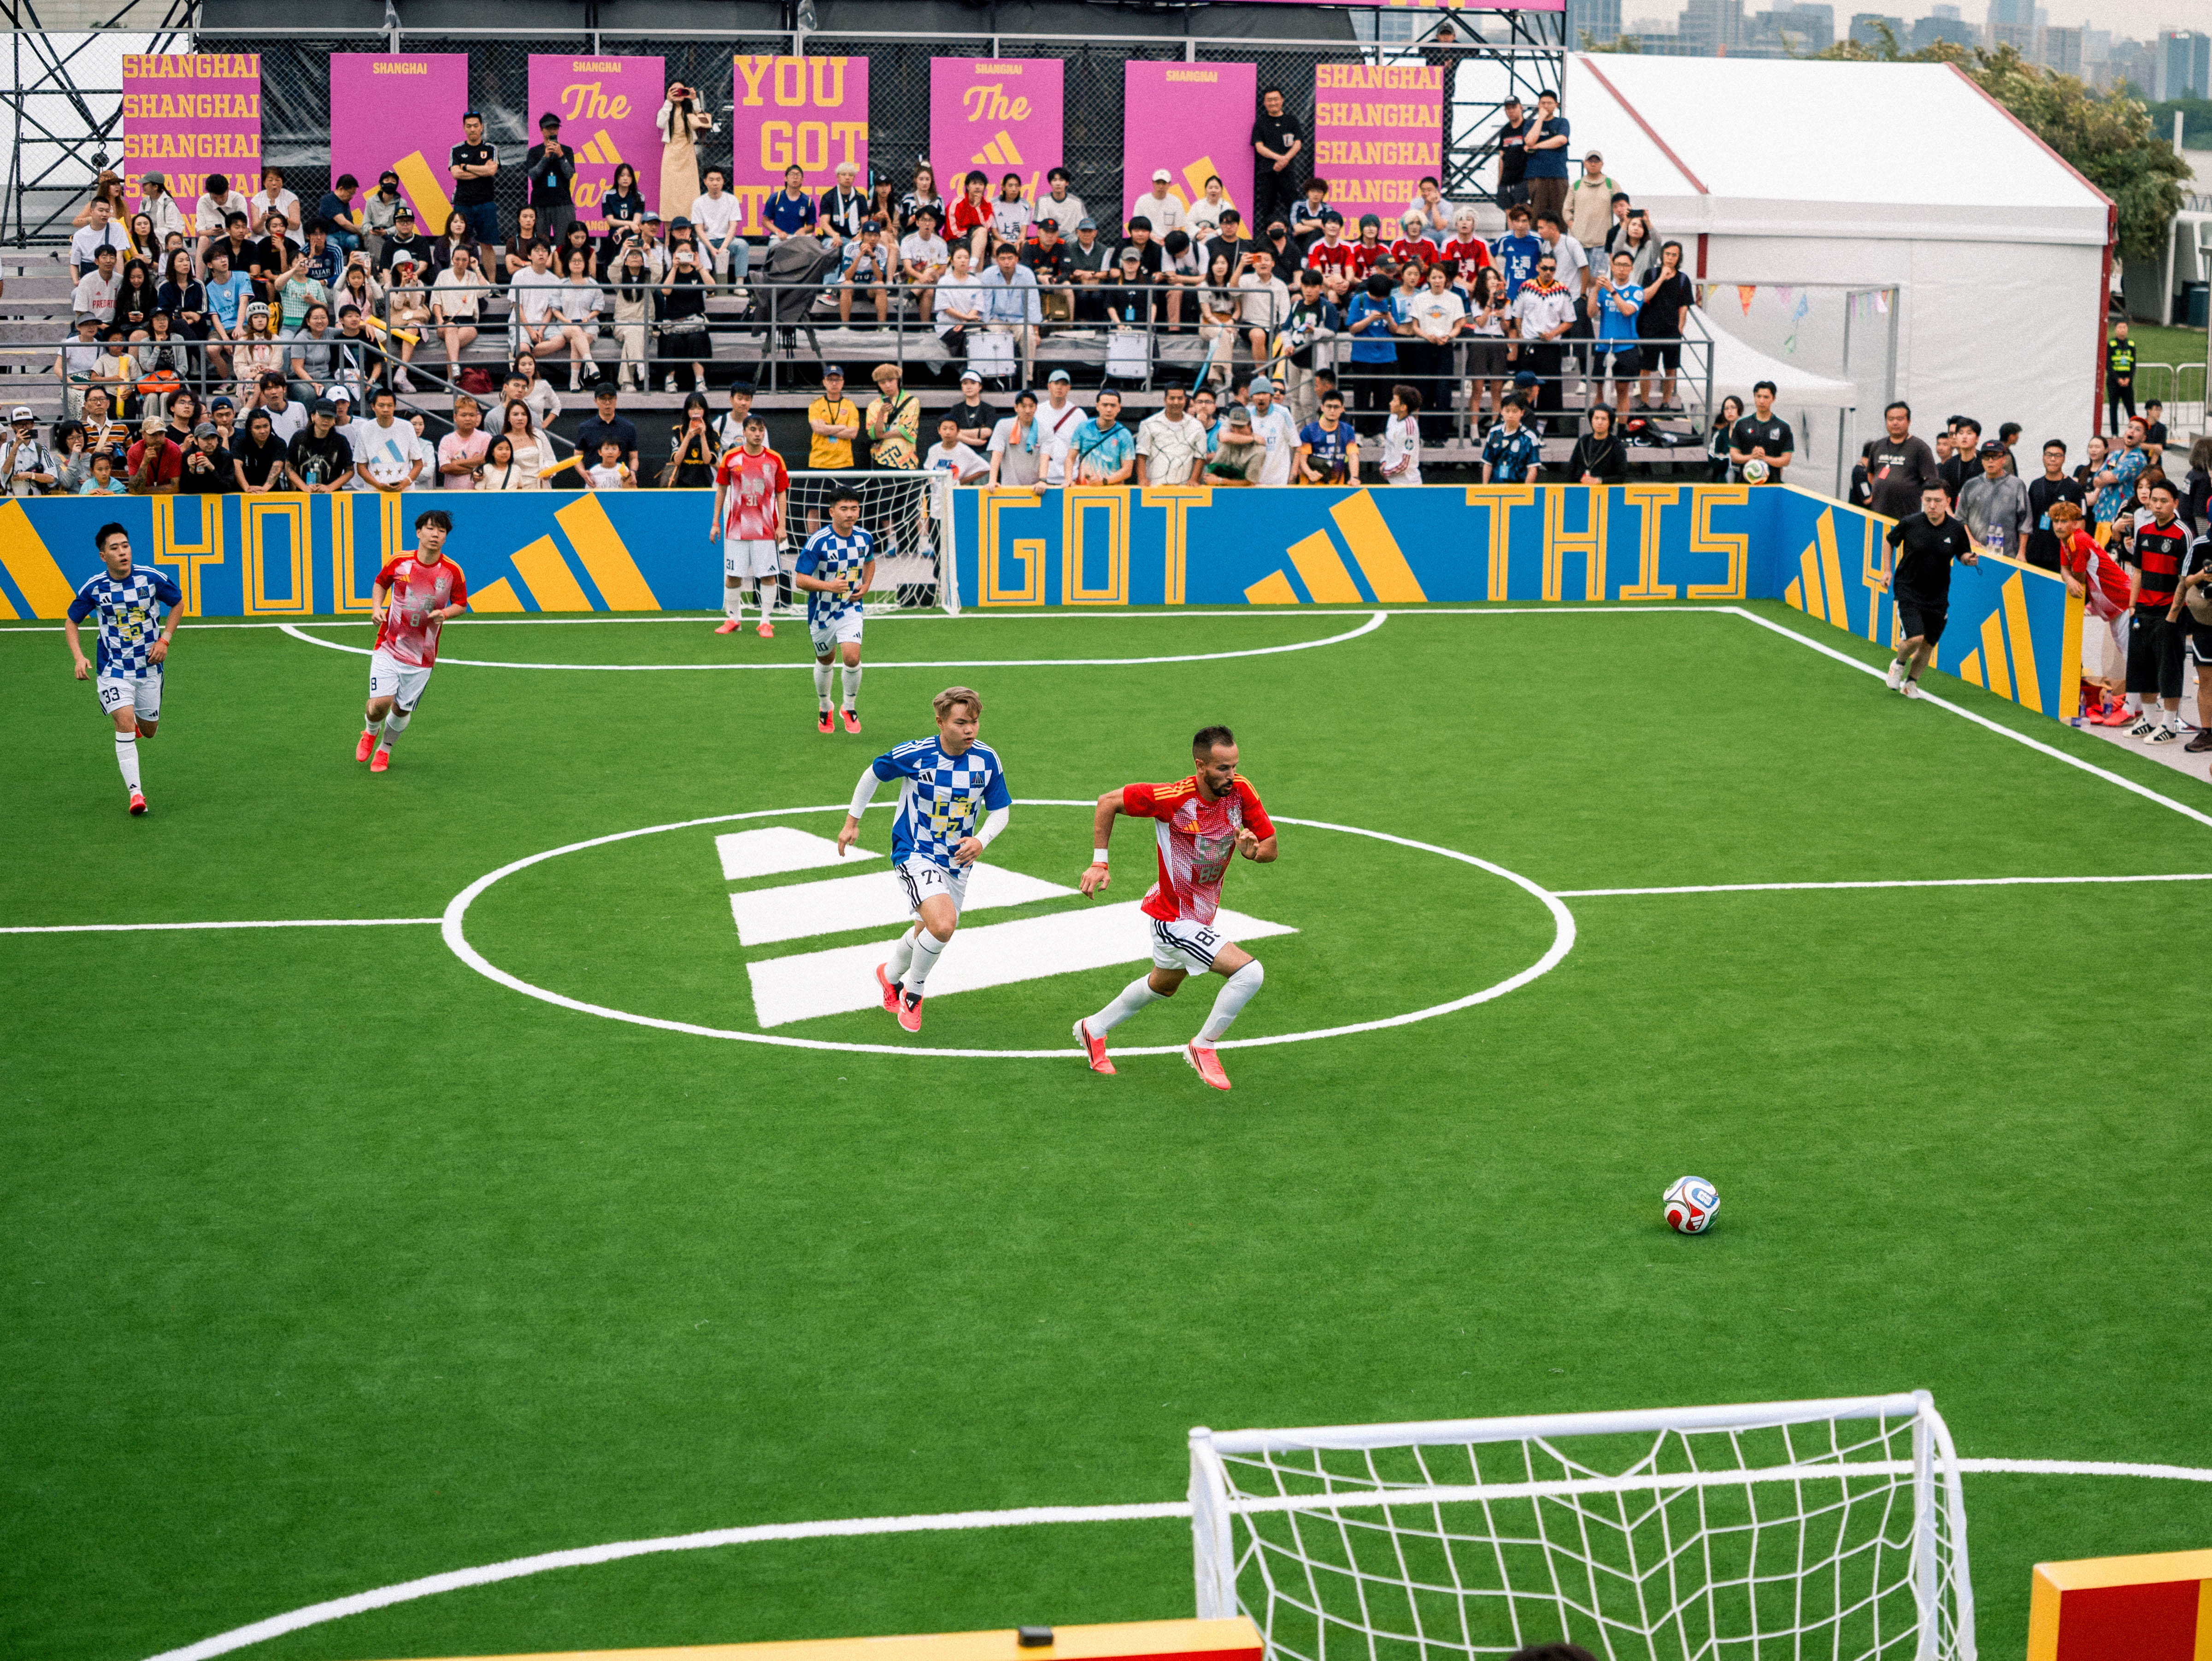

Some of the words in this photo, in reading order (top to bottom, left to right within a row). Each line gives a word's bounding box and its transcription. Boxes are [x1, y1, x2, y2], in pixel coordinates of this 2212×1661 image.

[123, 54, 259, 78] SHANGHAI
[373, 62, 427, 74] SHANGHAI
[572, 61, 621, 72] SHANGHAI
[975, 63, 1022, 74] SHANGHAI
[1166, 70, 1218, 82] SHANGHAI
[1317, 65, 1442, 89] SHANGHAI
[734, 56, 847, 106] YOU
[124, 94, 259, 118] SHANGHAI
[561, 82, 632, 120] The
[963, 83, 1032, 122] The
[1316, 103, 1441, 127] SHANGHAI
[124, 134, 260, 158] SHANGHAI
[761, 121, 868, 171] GOT
[1315, 141, 1441, 165] SHANGHAI
[125, 174, 260, 197] SANAI
[1322, 179, 1422, 203] HANGH
[746, 494, 758, 507] 31
[152, 491, 402, 617] YOU
[978, 487, 1212, 607] GOT
[1465, 486, 1749, 601] THIS
[726, 559, 734, 571] 31
[402, 591, 437, 613] 上海
[114, 606, 146, 628] 上海
[410, 613, 420, 627] 8
[123, 626, 141, 642] 33
[814, 642, 829, 652] 10
[371, 677, 377, 691] 8
[102, 687, 120, 704] 33
[927, 795, 974, 820] 上海
[935, 821, 959, 838] 77
[1191, 834, 1235, 865] 上海
[921, 870, 943, 885] 77
[1198, 865, 1223, 884] 89
